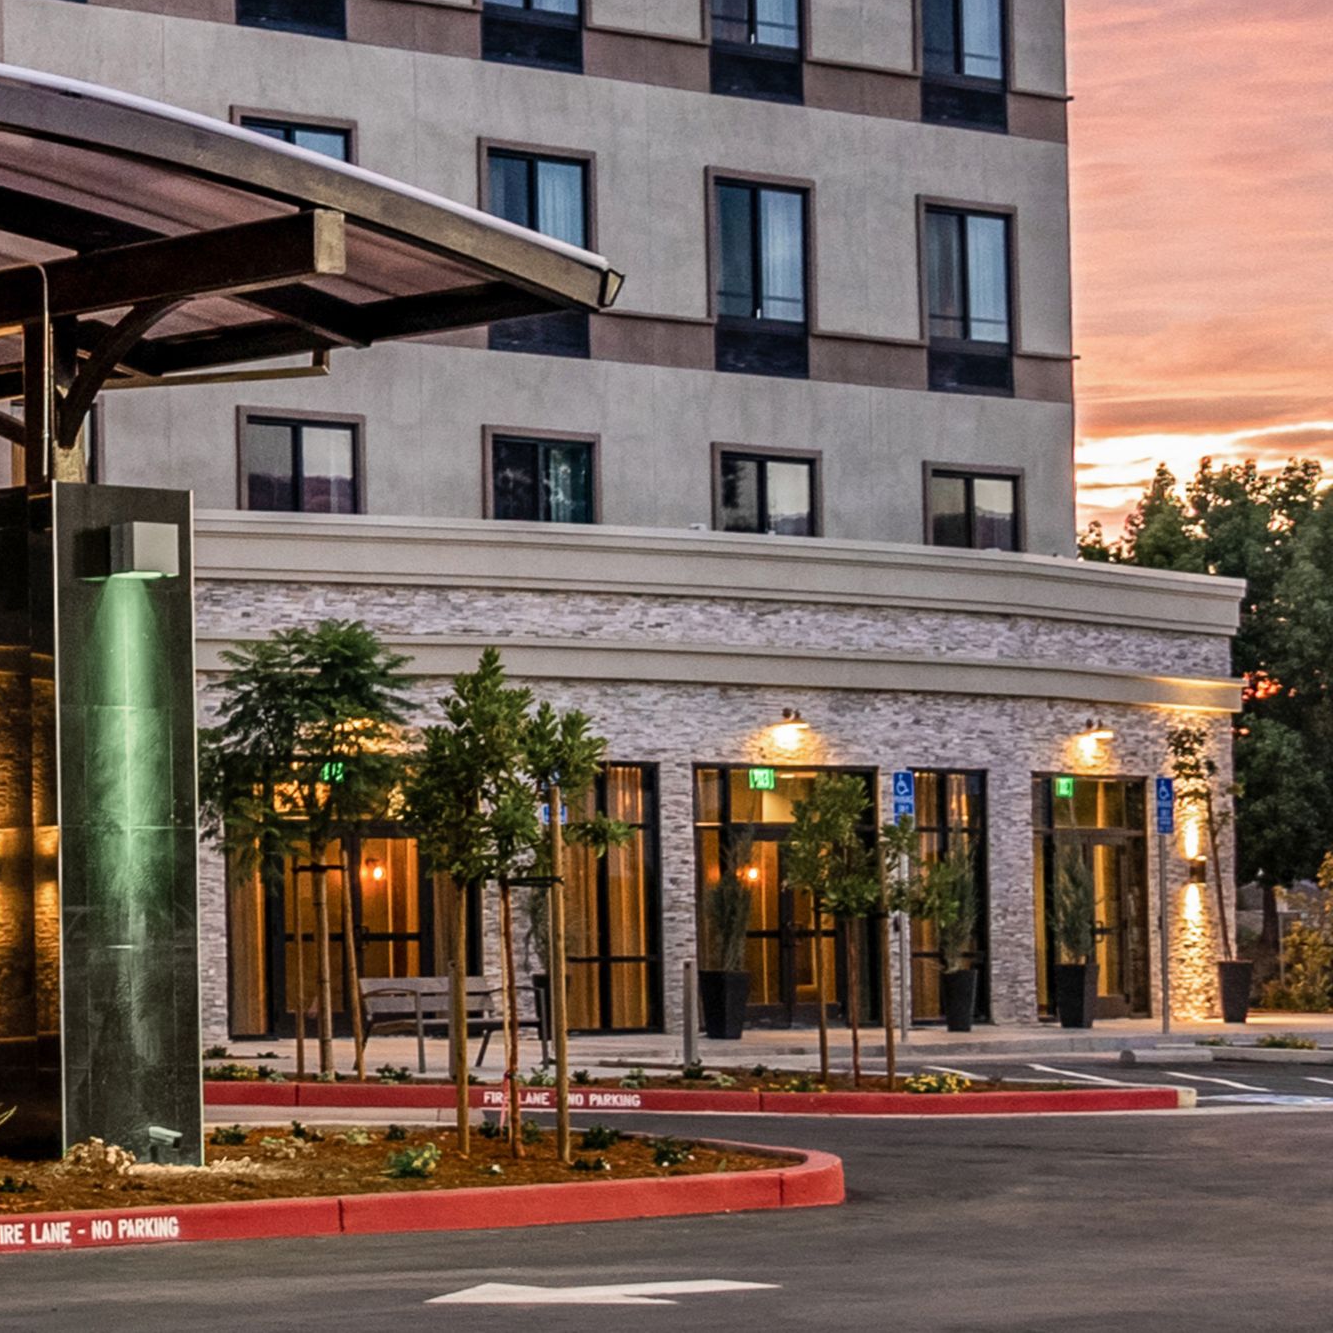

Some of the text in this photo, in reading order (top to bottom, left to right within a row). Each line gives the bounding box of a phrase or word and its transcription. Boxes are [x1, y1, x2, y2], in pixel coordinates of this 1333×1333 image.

[484, 1091, 641, 1107] FIR LANE NO PARKING
[31, 1222, 71, 1244] LANE
[91, 1220, 112, 1240] NO
[118, 1216, 179, 1239] PARKING
